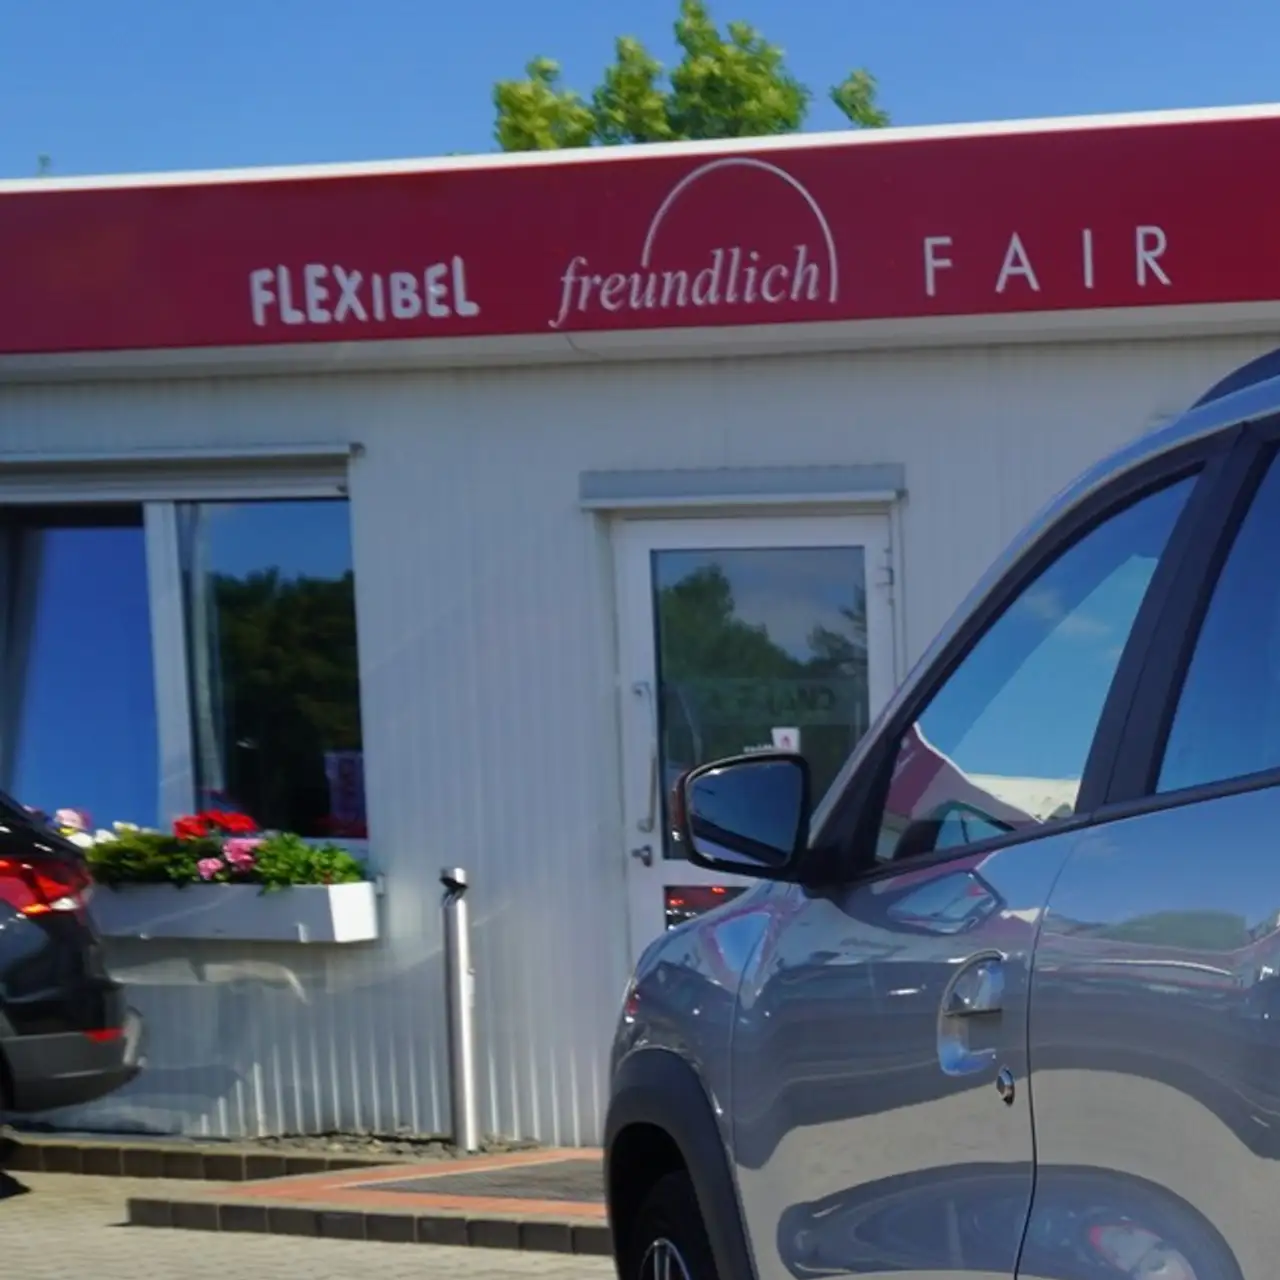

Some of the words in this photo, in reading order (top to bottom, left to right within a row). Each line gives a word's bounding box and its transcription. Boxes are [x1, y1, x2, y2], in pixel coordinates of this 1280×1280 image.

[249, 254, 480, 327] FLEXIBEL
[547, 244, 820, 329] freundlich
[923, 224, 1172, 297] FAIR
